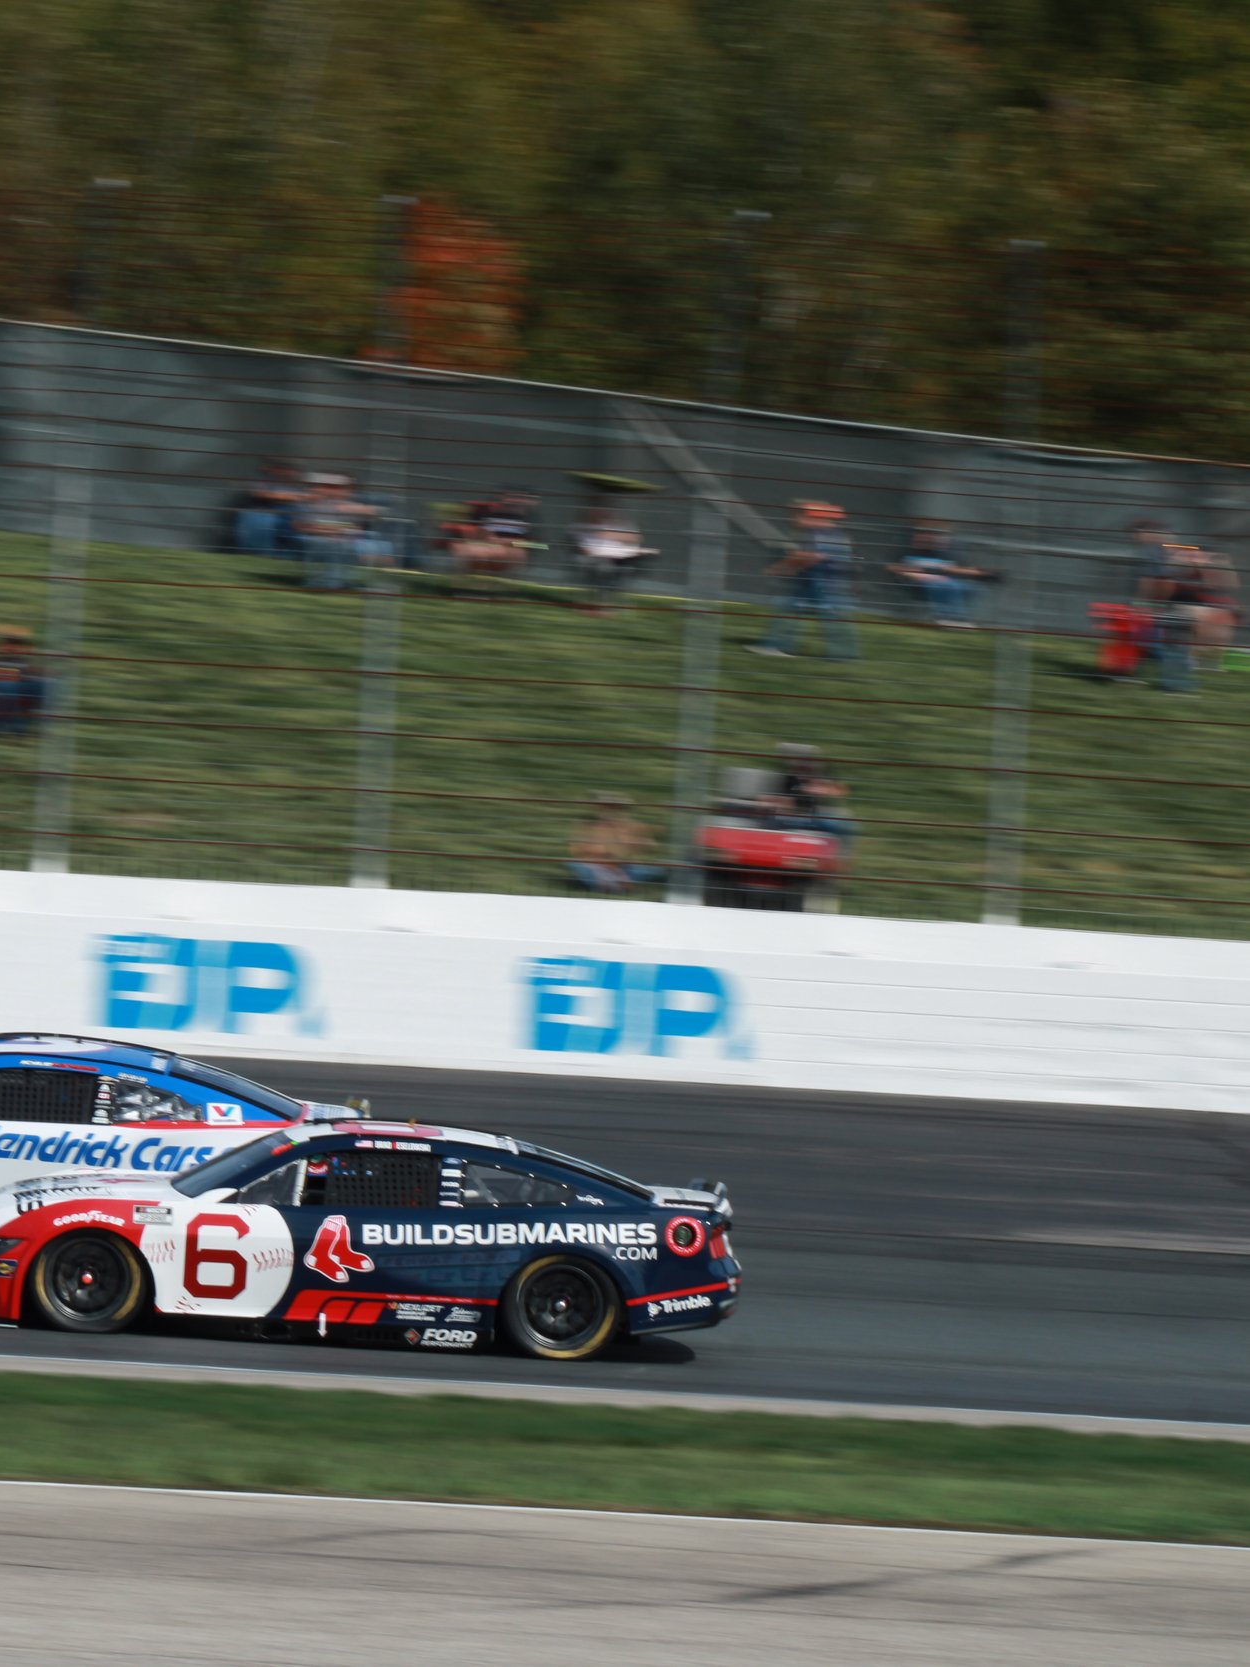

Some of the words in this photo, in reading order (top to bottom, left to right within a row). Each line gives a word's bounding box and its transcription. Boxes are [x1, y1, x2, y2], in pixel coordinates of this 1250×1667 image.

[53, 1210, 126, 1227] GOODYEAR
[361, 1222, 658, 1246] BUILDSUBMARINES
[183, 1213, 250, 1300] 6
[612, 1246, 658, 1262] .COM
[661, 1294, 713, 1314] Trimble
[422, 1327, 478, 1344] FORD
